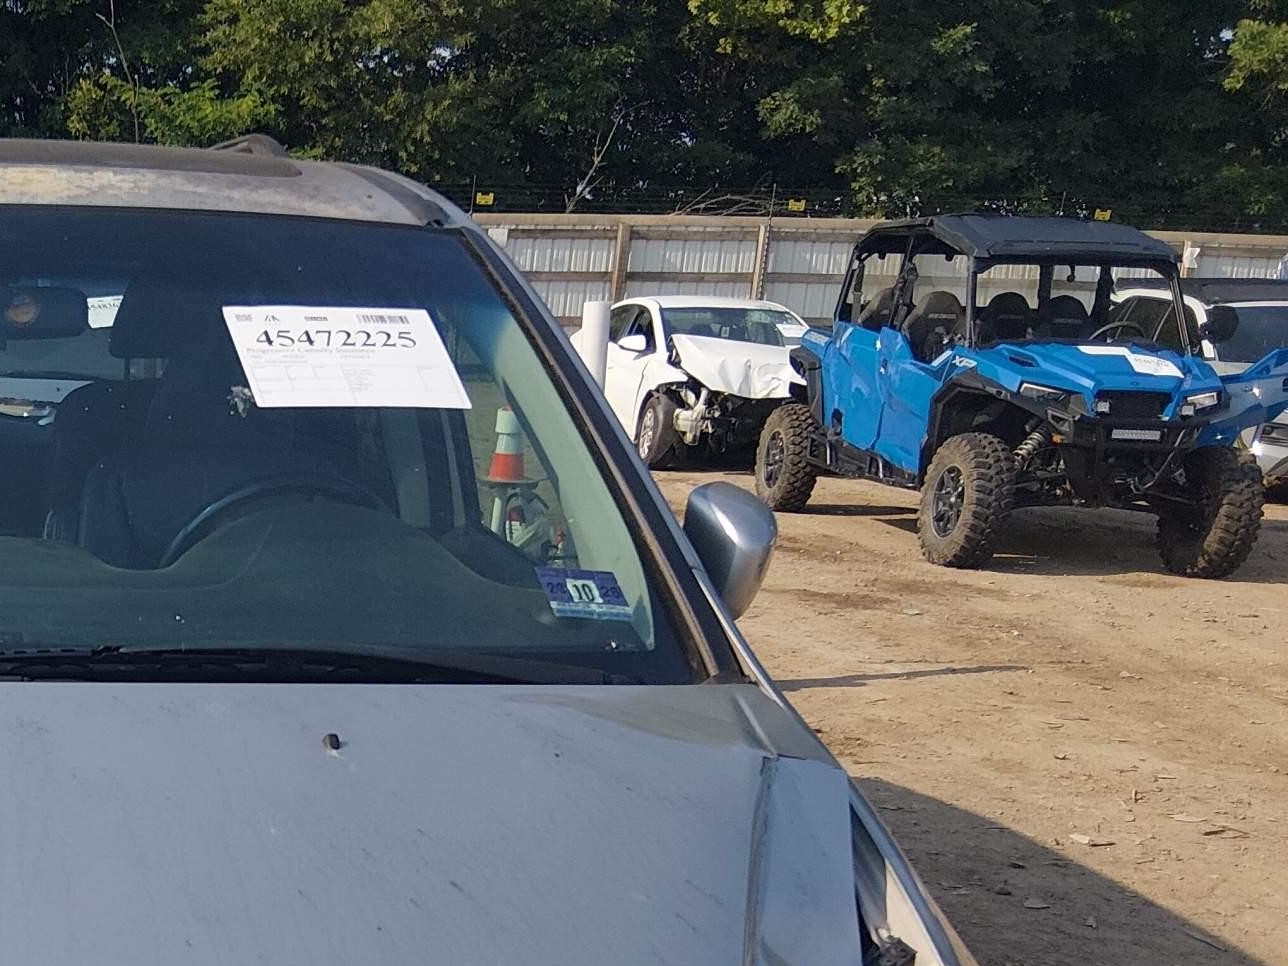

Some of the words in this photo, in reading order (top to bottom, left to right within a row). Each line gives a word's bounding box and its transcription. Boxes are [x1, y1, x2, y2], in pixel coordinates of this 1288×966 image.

[255, 329, 417, 348] 45472225
[246, 347, 295, 355] Progressive
[572, 583, 596, 602] 10
